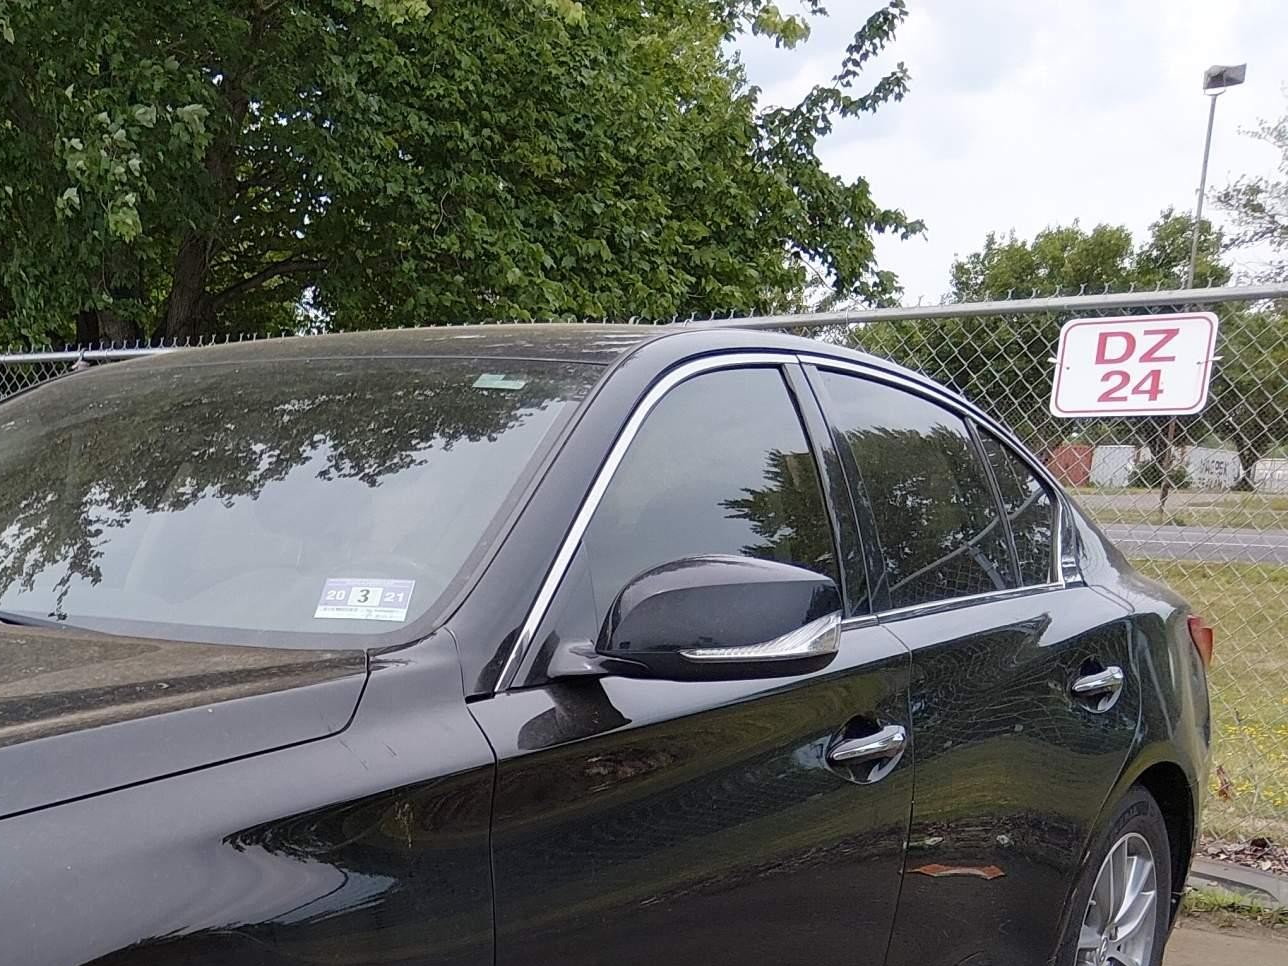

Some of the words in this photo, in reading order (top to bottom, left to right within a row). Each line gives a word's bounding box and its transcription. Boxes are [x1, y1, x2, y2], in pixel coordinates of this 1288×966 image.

[1095, 328, 1180, 365] DZ
[1097, 369, 1164, 403] 24
[325, 590, 346, 601] 20
[357, 588, 370, 604] 3
[383, 592, 405, 602] 21
